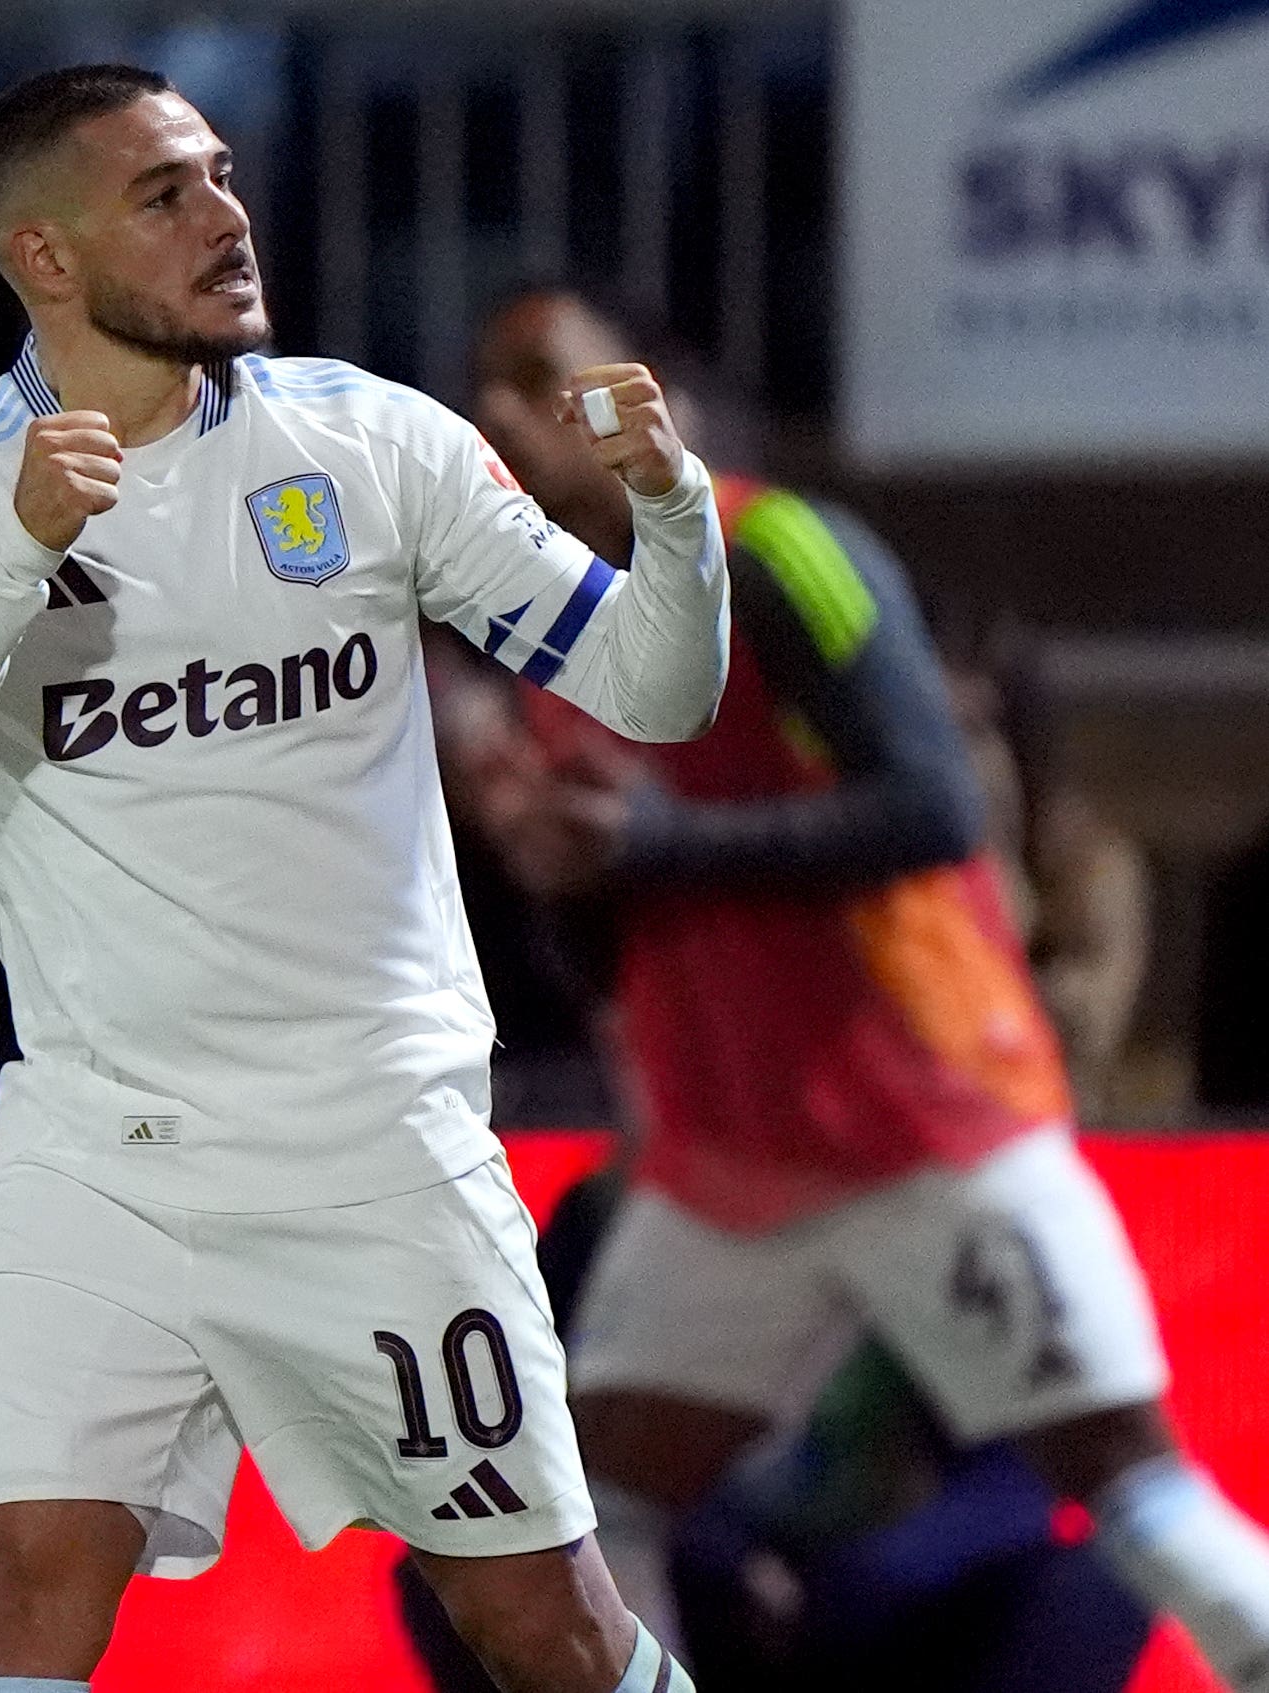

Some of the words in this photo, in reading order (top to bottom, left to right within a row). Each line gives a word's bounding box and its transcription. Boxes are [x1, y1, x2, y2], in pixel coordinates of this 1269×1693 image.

[958, 143, 1269, 258] SKY
[279, 562, 316, 574] ASTON
[317, 553, 342, 571] VILLA
[42, 632, 378, 762] Betano
[372, 1307, 524, 1459] 10
